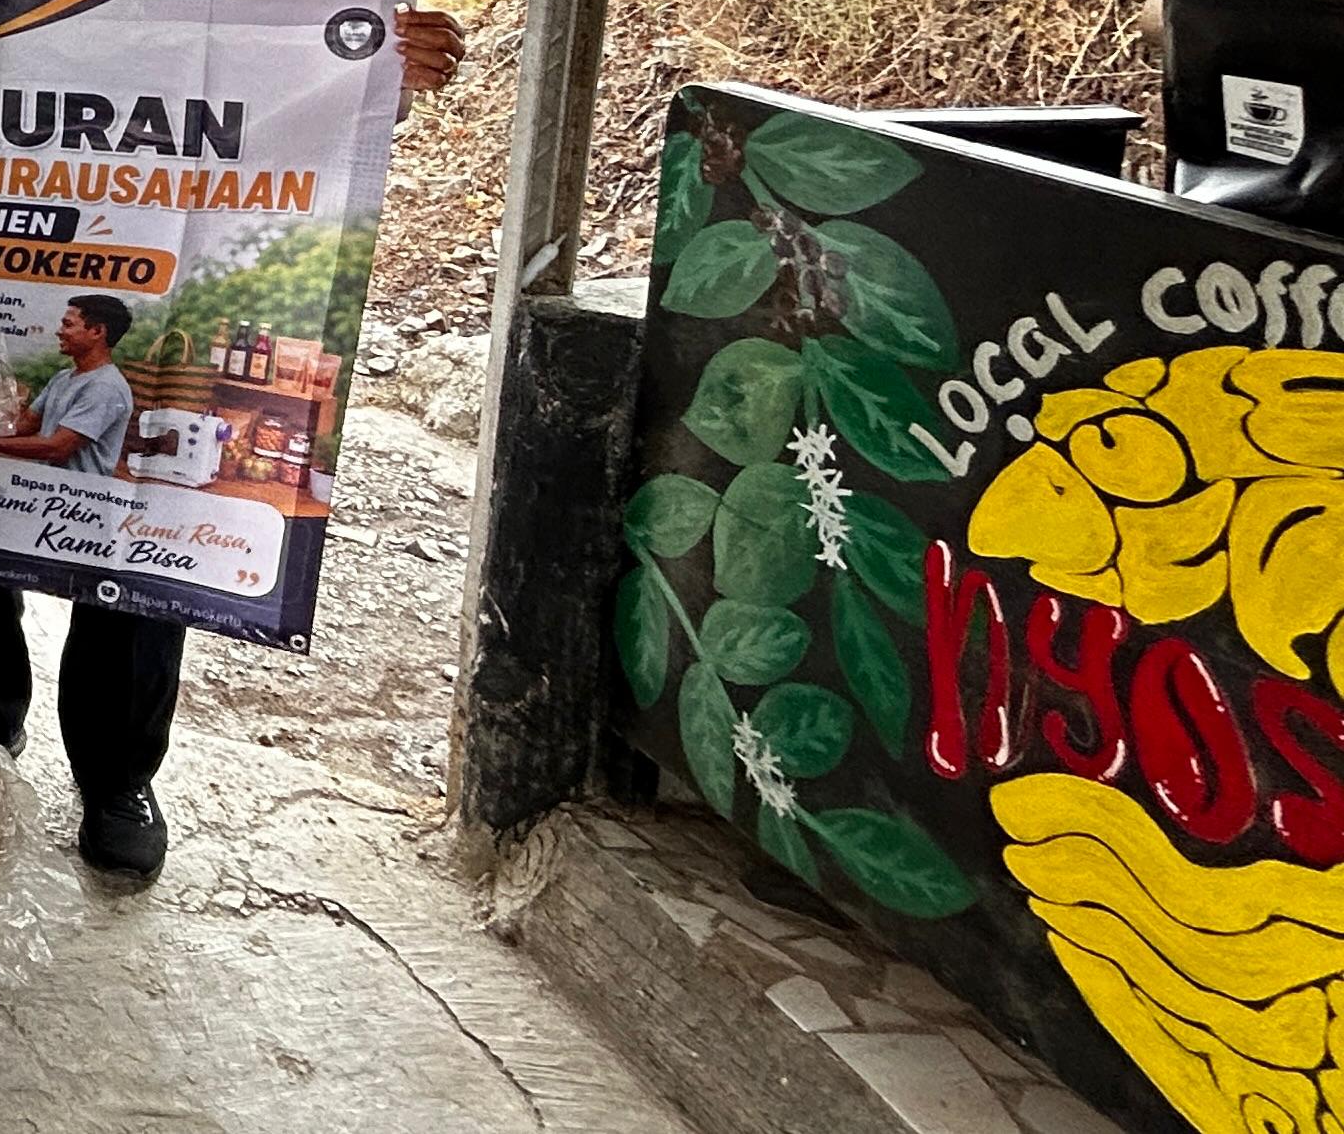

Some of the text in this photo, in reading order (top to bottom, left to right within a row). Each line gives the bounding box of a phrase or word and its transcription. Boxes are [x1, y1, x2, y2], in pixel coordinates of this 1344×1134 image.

[11, 474, 149, 511] Bapas Purwokerto:
[35, 521, 199, 572] Kami Bisa
[41, 495, 106, 530] Pikir,
[118, 512, 183, 541] Kami
[188, 522, 253, 555] Rasa,
[130, 590, 243, 628] Bapas Purwokerto
